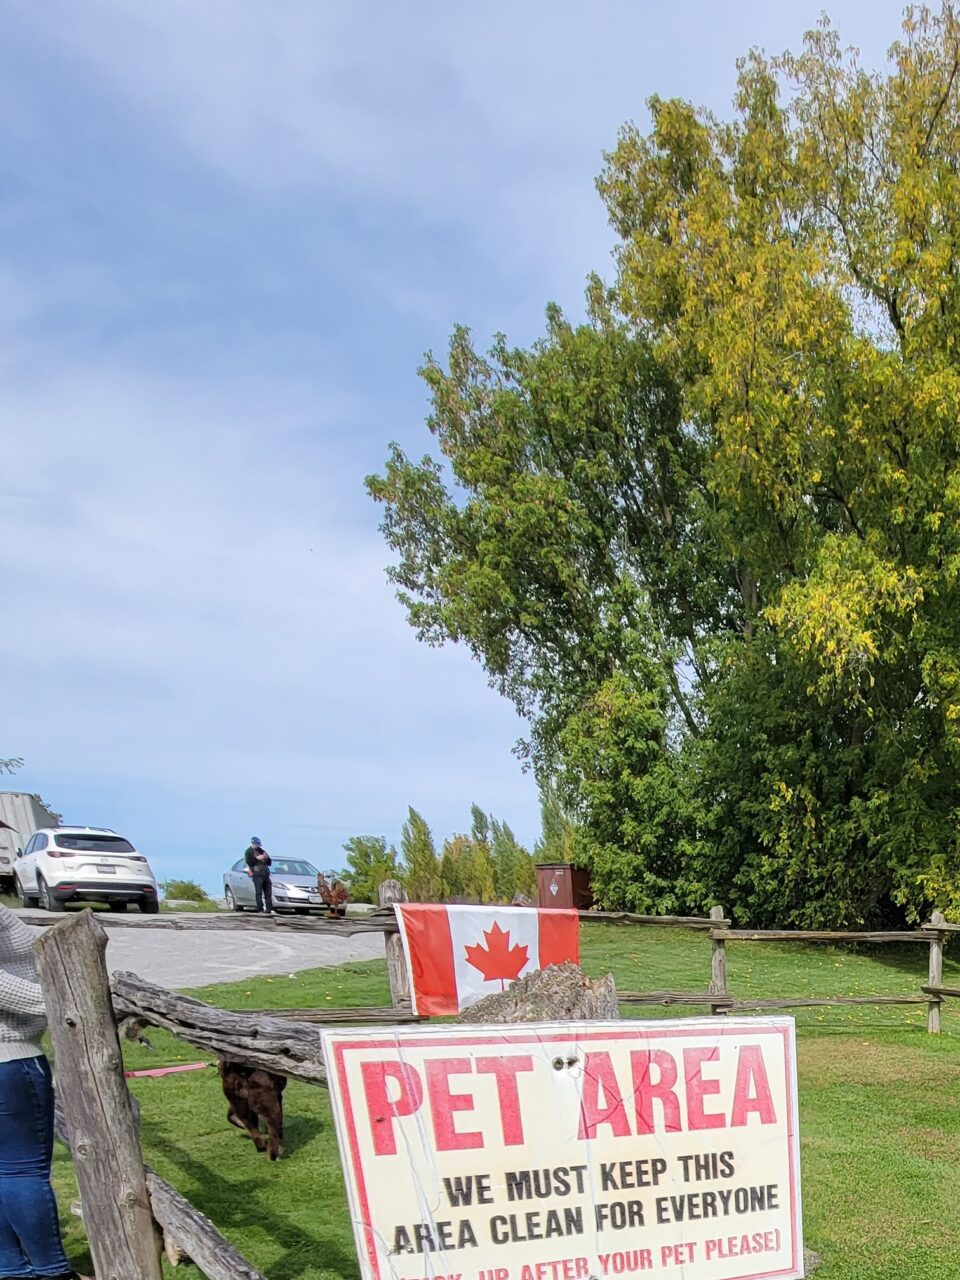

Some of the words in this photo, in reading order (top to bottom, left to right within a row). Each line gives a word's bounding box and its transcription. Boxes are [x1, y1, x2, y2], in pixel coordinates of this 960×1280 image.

[360, 1055, 534, 1156] PET
[577, 1045, 777, 1139] AREA
[444, 1174, 495, 1207] WE
[505, 1165, 588, 1201] MUST
[600, 1157, 668, 1191] KEEP
[677, 1151, 736, 1182] THIS
[393, 1223, 478, 1255] AREA
[490, 1207, 584, 1245] CLEAN
[595, 1200, 646, 1232] FOR
[656, 1183, 780, 1225] EVERYONE
[597, 1248, 653, 1275] YOUR
[661, 1242, 697, 1266] PET
[705, 1228, 782, 1259] PLEASE)
